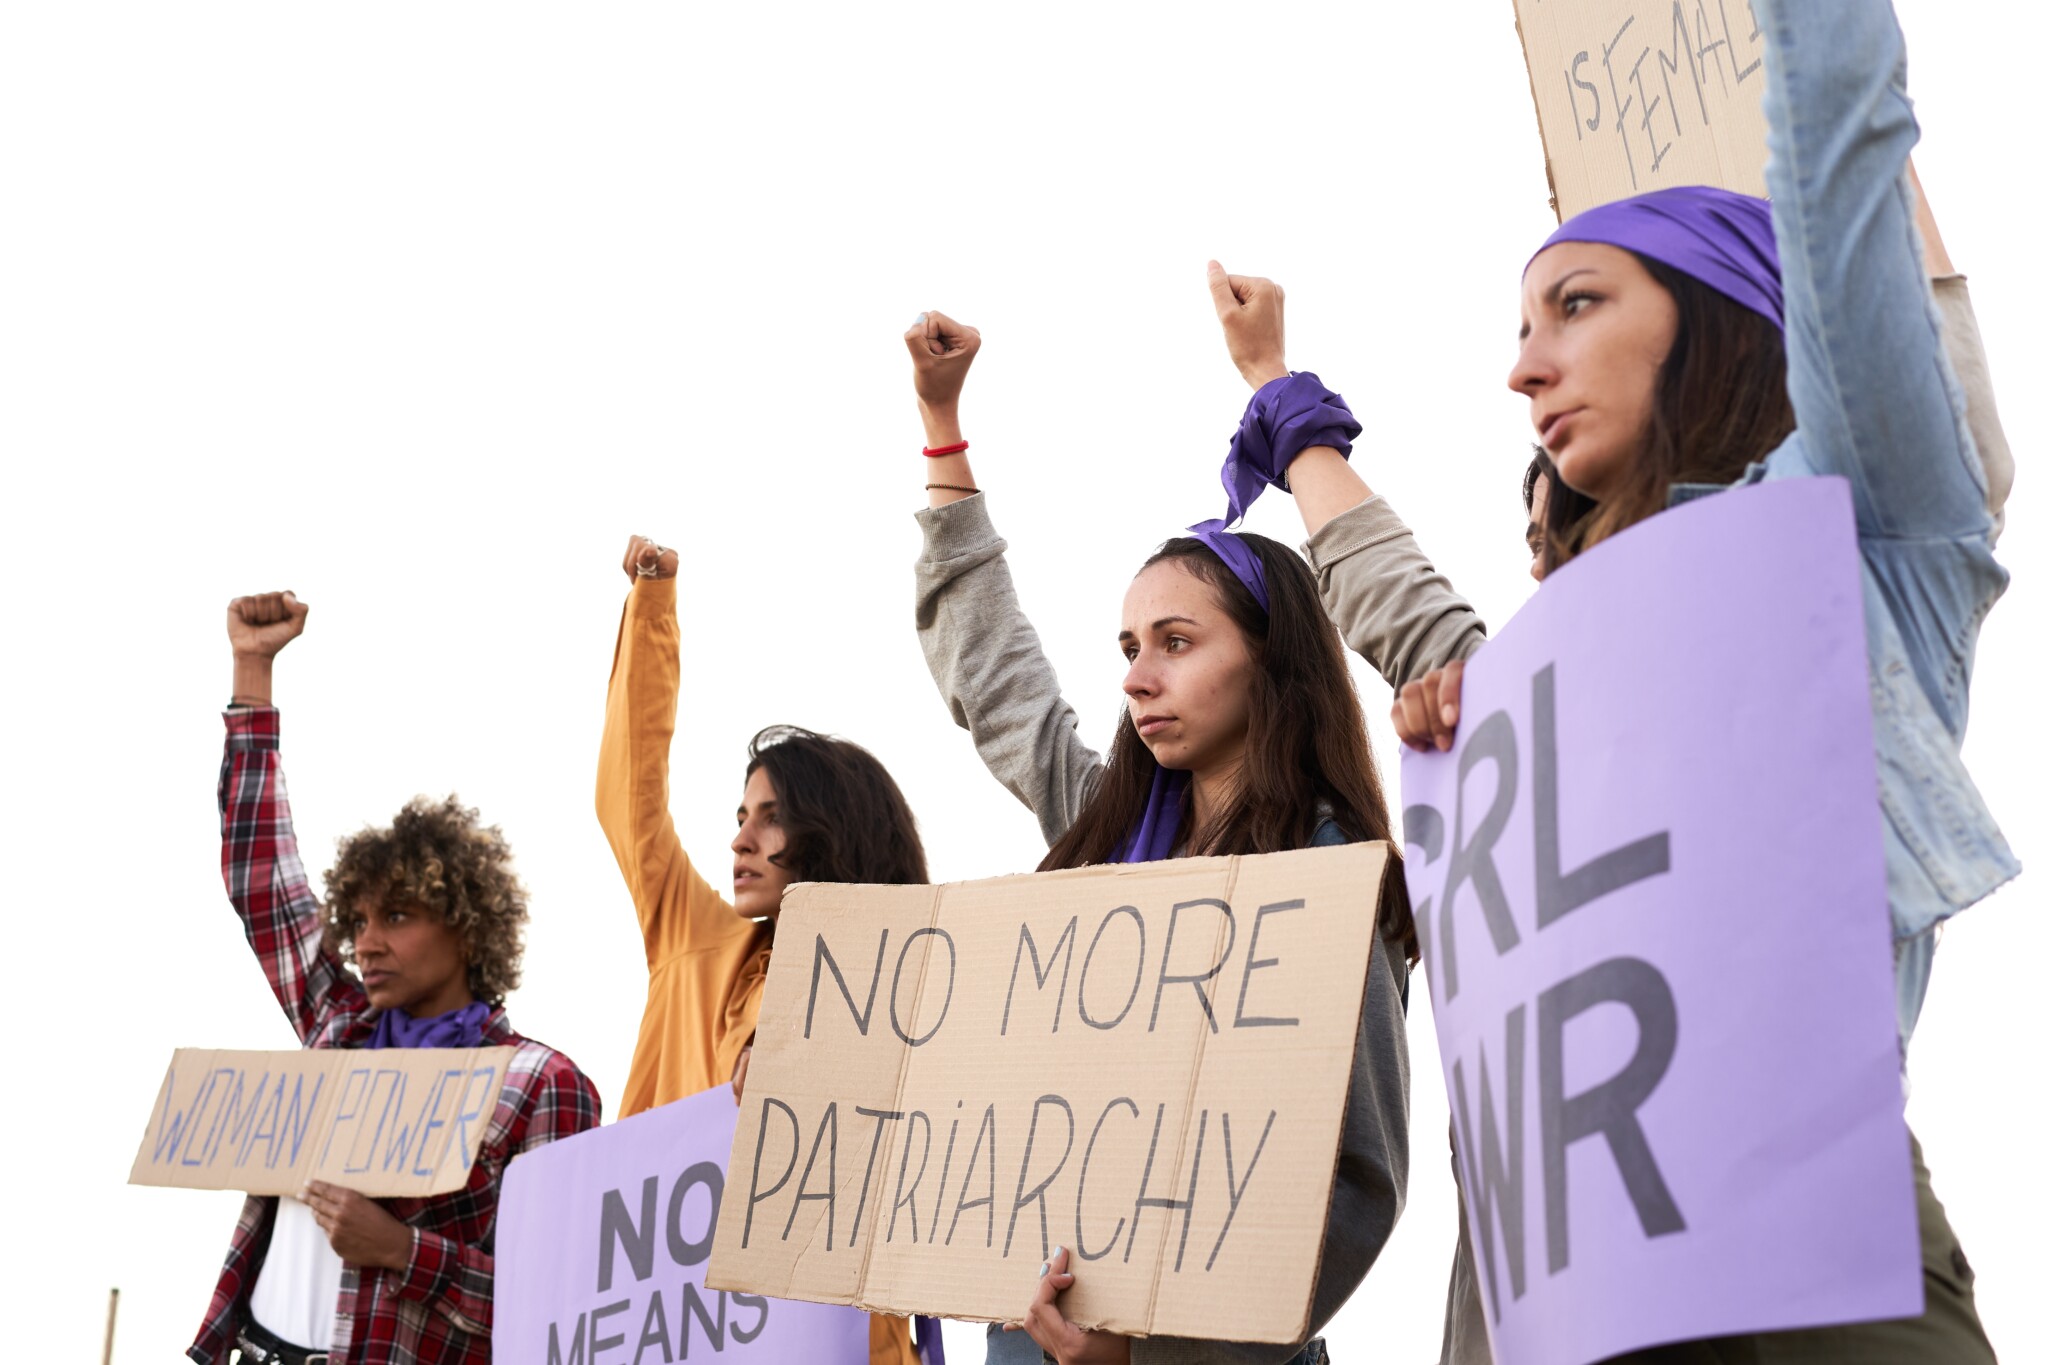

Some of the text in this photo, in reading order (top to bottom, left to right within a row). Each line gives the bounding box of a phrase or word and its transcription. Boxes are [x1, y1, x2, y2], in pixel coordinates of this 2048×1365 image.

[1564, 50, 1601, 141] IS
[804, 898, 1306, 1047] NO MORE
[152, 1066, 496, 1176] WOMAN POWER
[597, 1160, 725, 1293] NO
